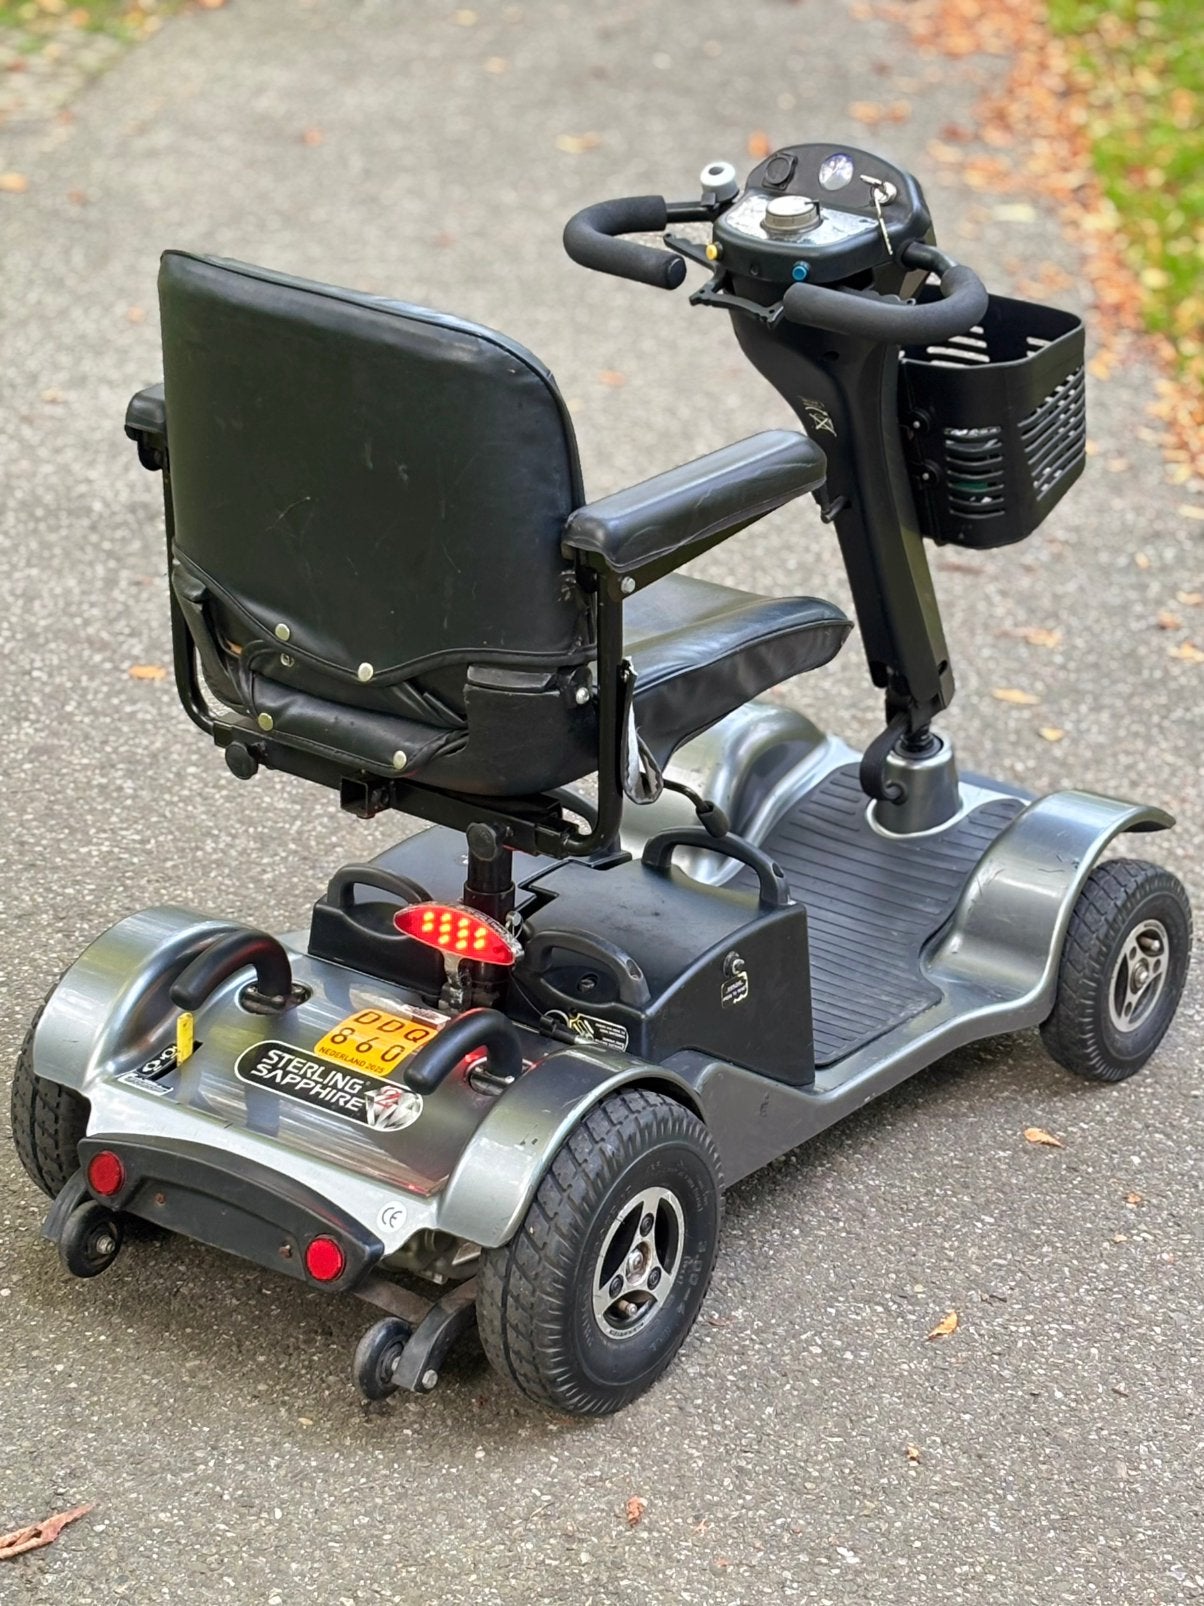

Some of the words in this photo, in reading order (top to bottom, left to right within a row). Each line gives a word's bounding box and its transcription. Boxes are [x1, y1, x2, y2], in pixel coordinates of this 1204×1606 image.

[330, 1027, 406, 1062] 860
[354, 1011, 430, 1043] DDQ
[261, 1049, 364, 1094] STERLING
[318, 1046, 367, 1067] NEDERLAND
[365, 1063, 385, 1074] 2025
[250, 1062, 366, 1111] SAPPHIRE
